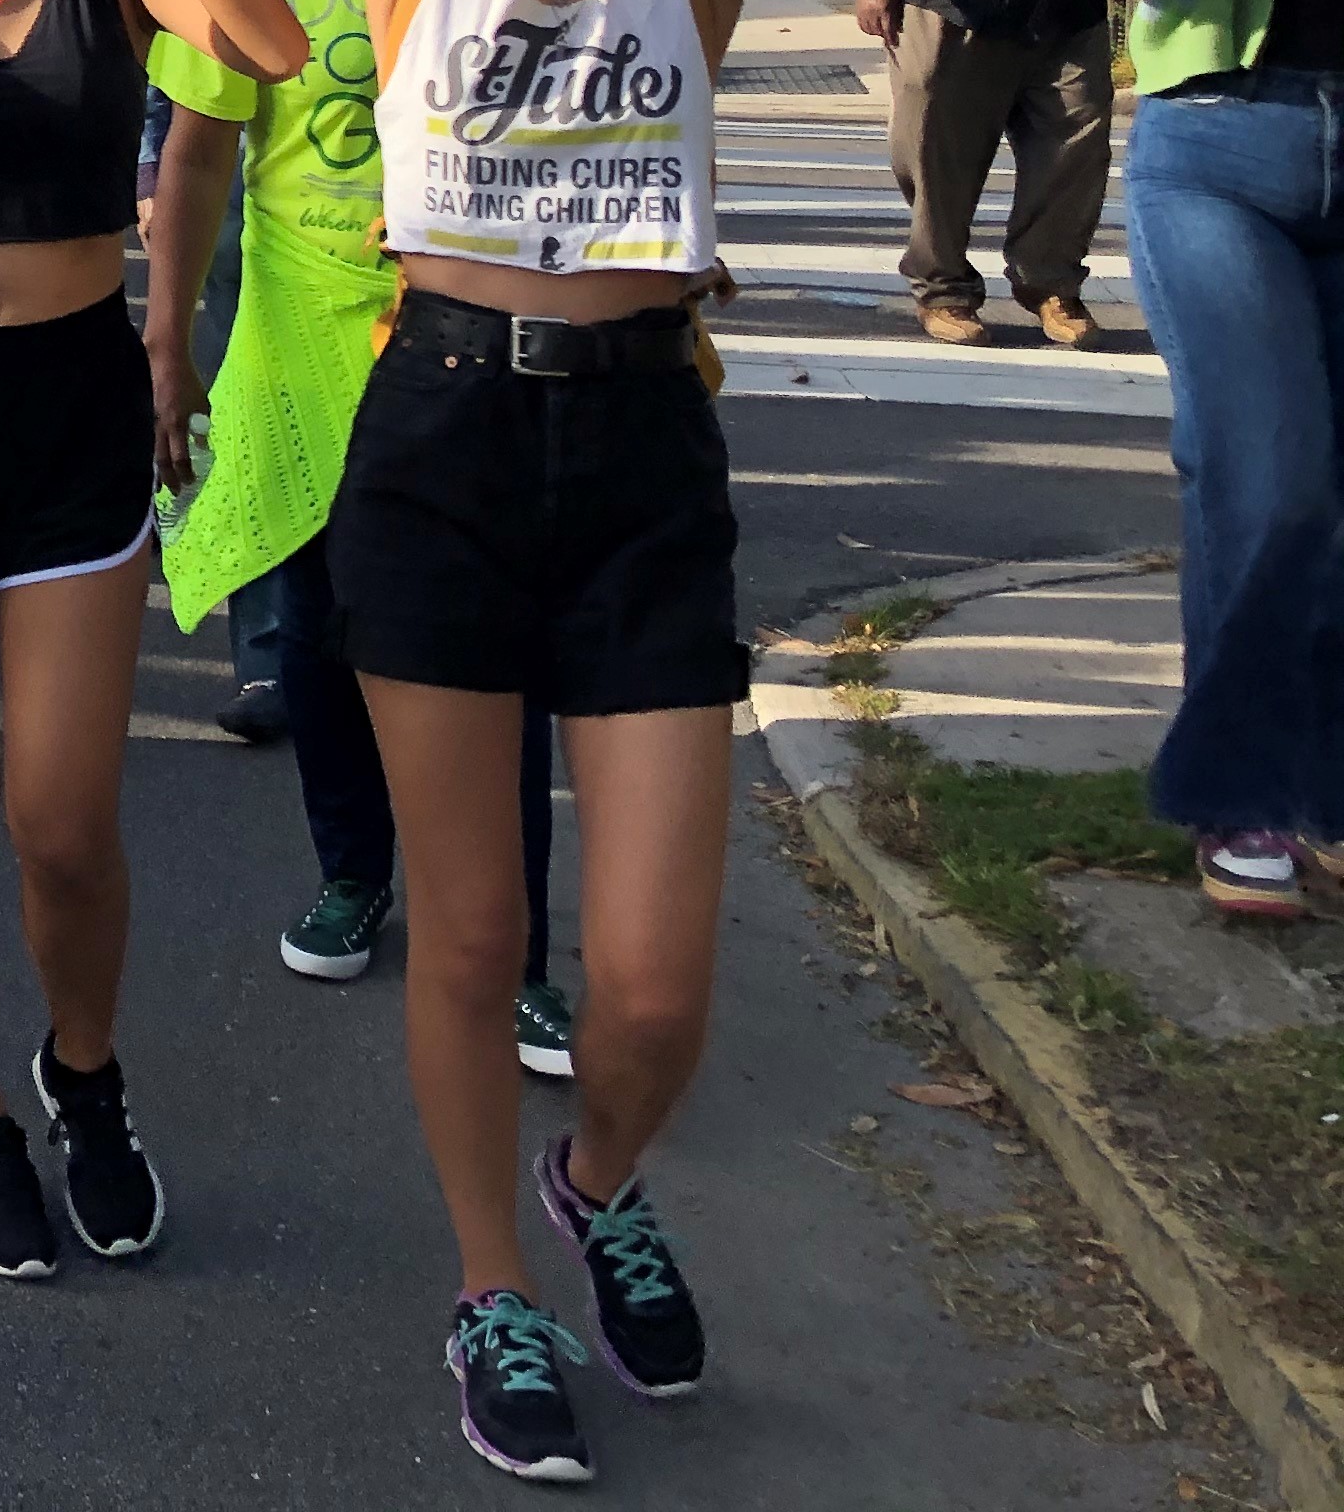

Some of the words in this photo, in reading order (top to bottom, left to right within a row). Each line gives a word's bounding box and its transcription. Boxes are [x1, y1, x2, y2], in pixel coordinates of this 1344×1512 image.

[452, 18, 683, 146] Jude
[424, 149, 558, 189] FINDING
[570, 156, 683, 190] CURES
[423, 185, 525, 222] SAVING
[535, 196, 682, 224] CHILDREN
